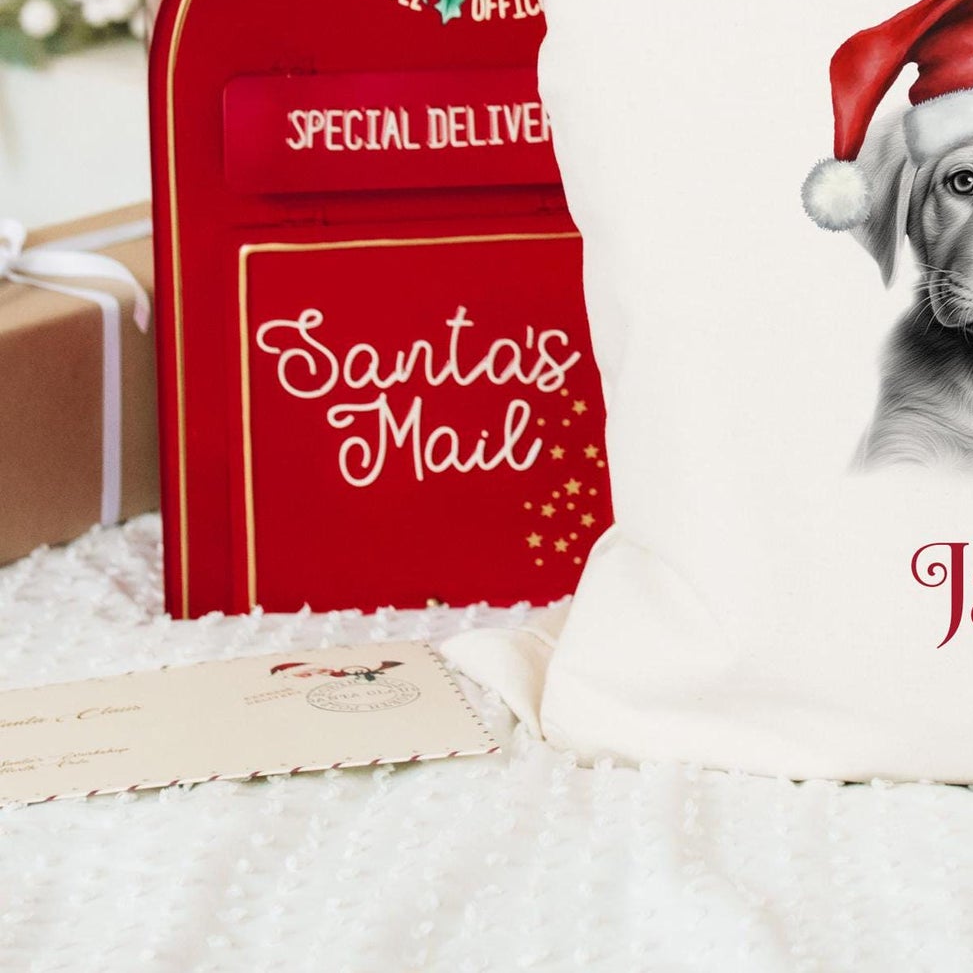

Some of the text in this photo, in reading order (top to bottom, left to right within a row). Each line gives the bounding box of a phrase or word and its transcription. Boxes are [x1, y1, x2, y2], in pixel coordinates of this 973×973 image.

[286, 104, 421, 151] SPECIAL
[256, 305, 581, 399] Santa's
[326, 392, 543, 487] Mail
